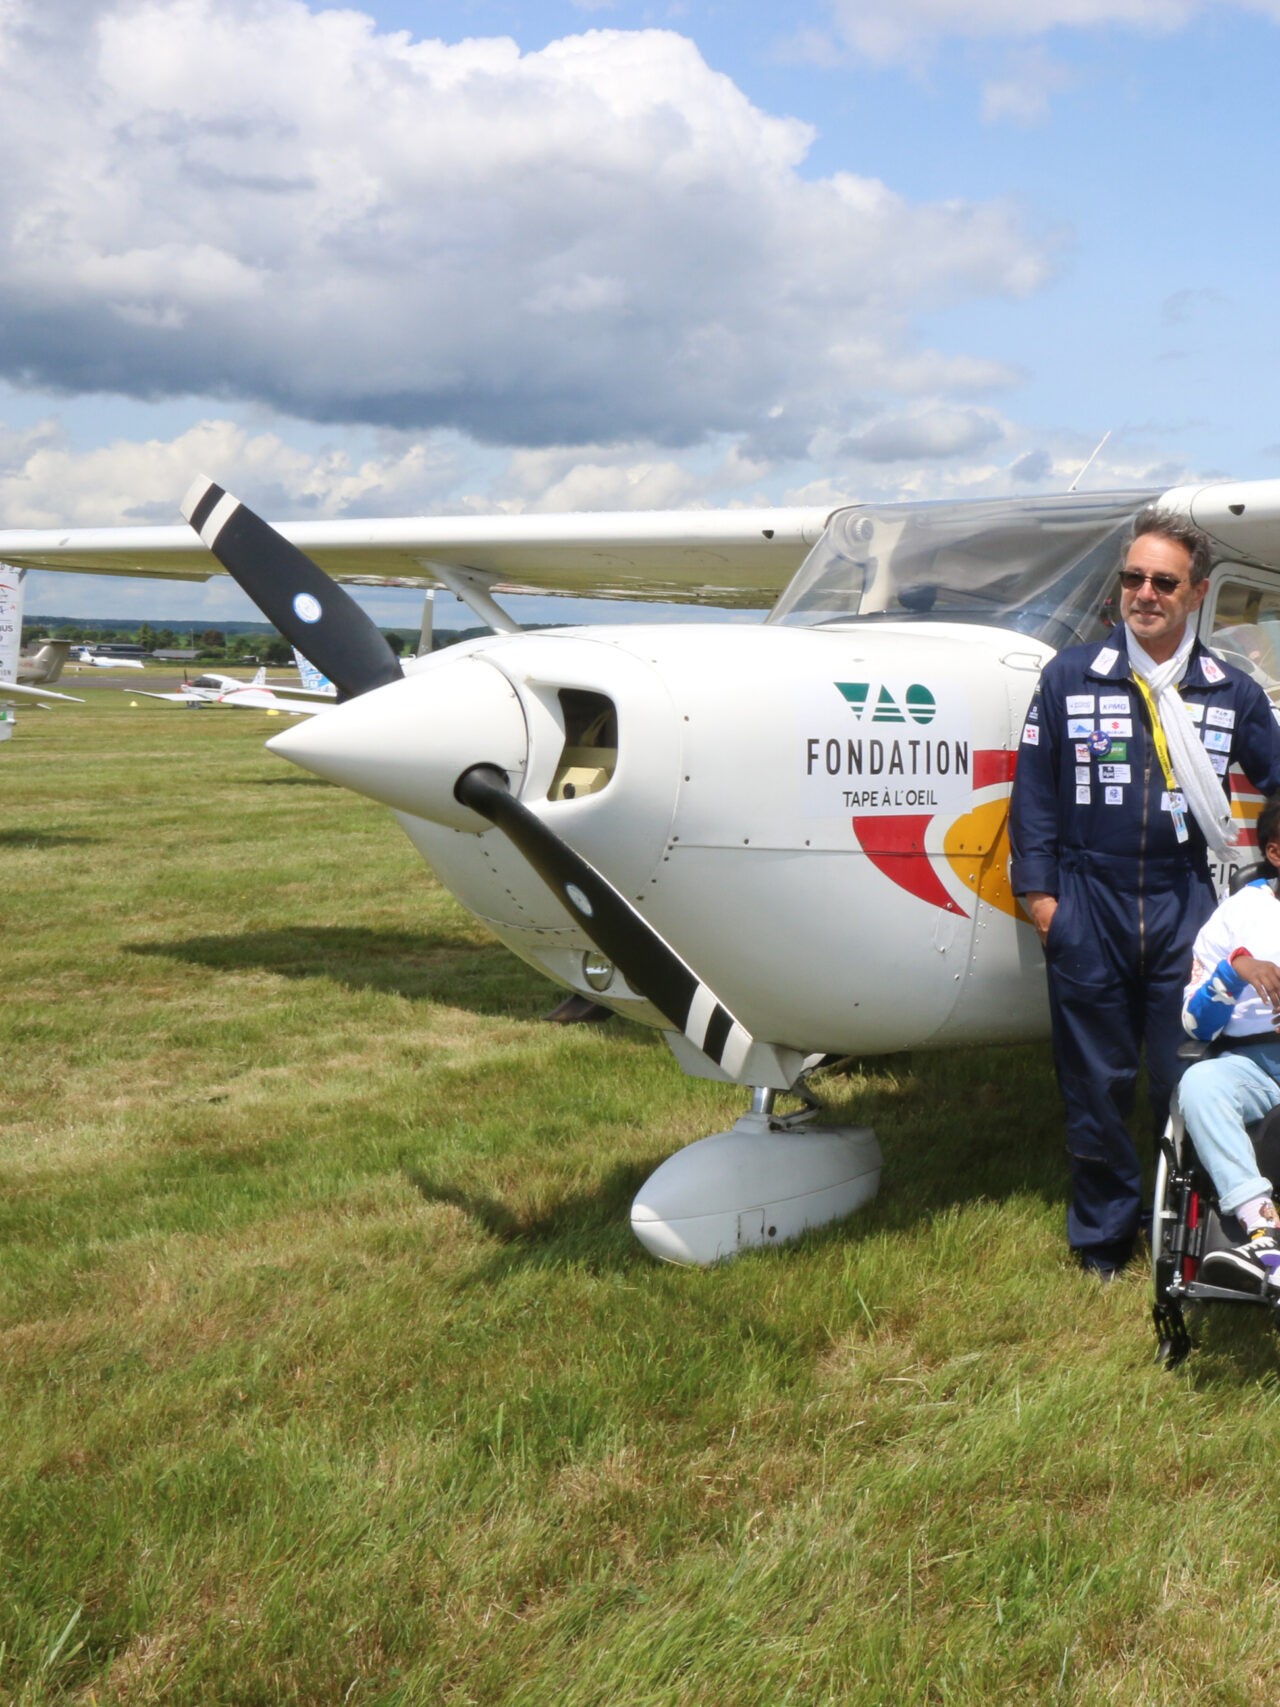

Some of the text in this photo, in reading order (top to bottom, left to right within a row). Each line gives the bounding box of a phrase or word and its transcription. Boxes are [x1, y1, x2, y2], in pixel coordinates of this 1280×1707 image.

[807, 738, 968, 775] FONDATION
[842, 790, 879, 807] TAPE
[882, 787, 892, 807] À
